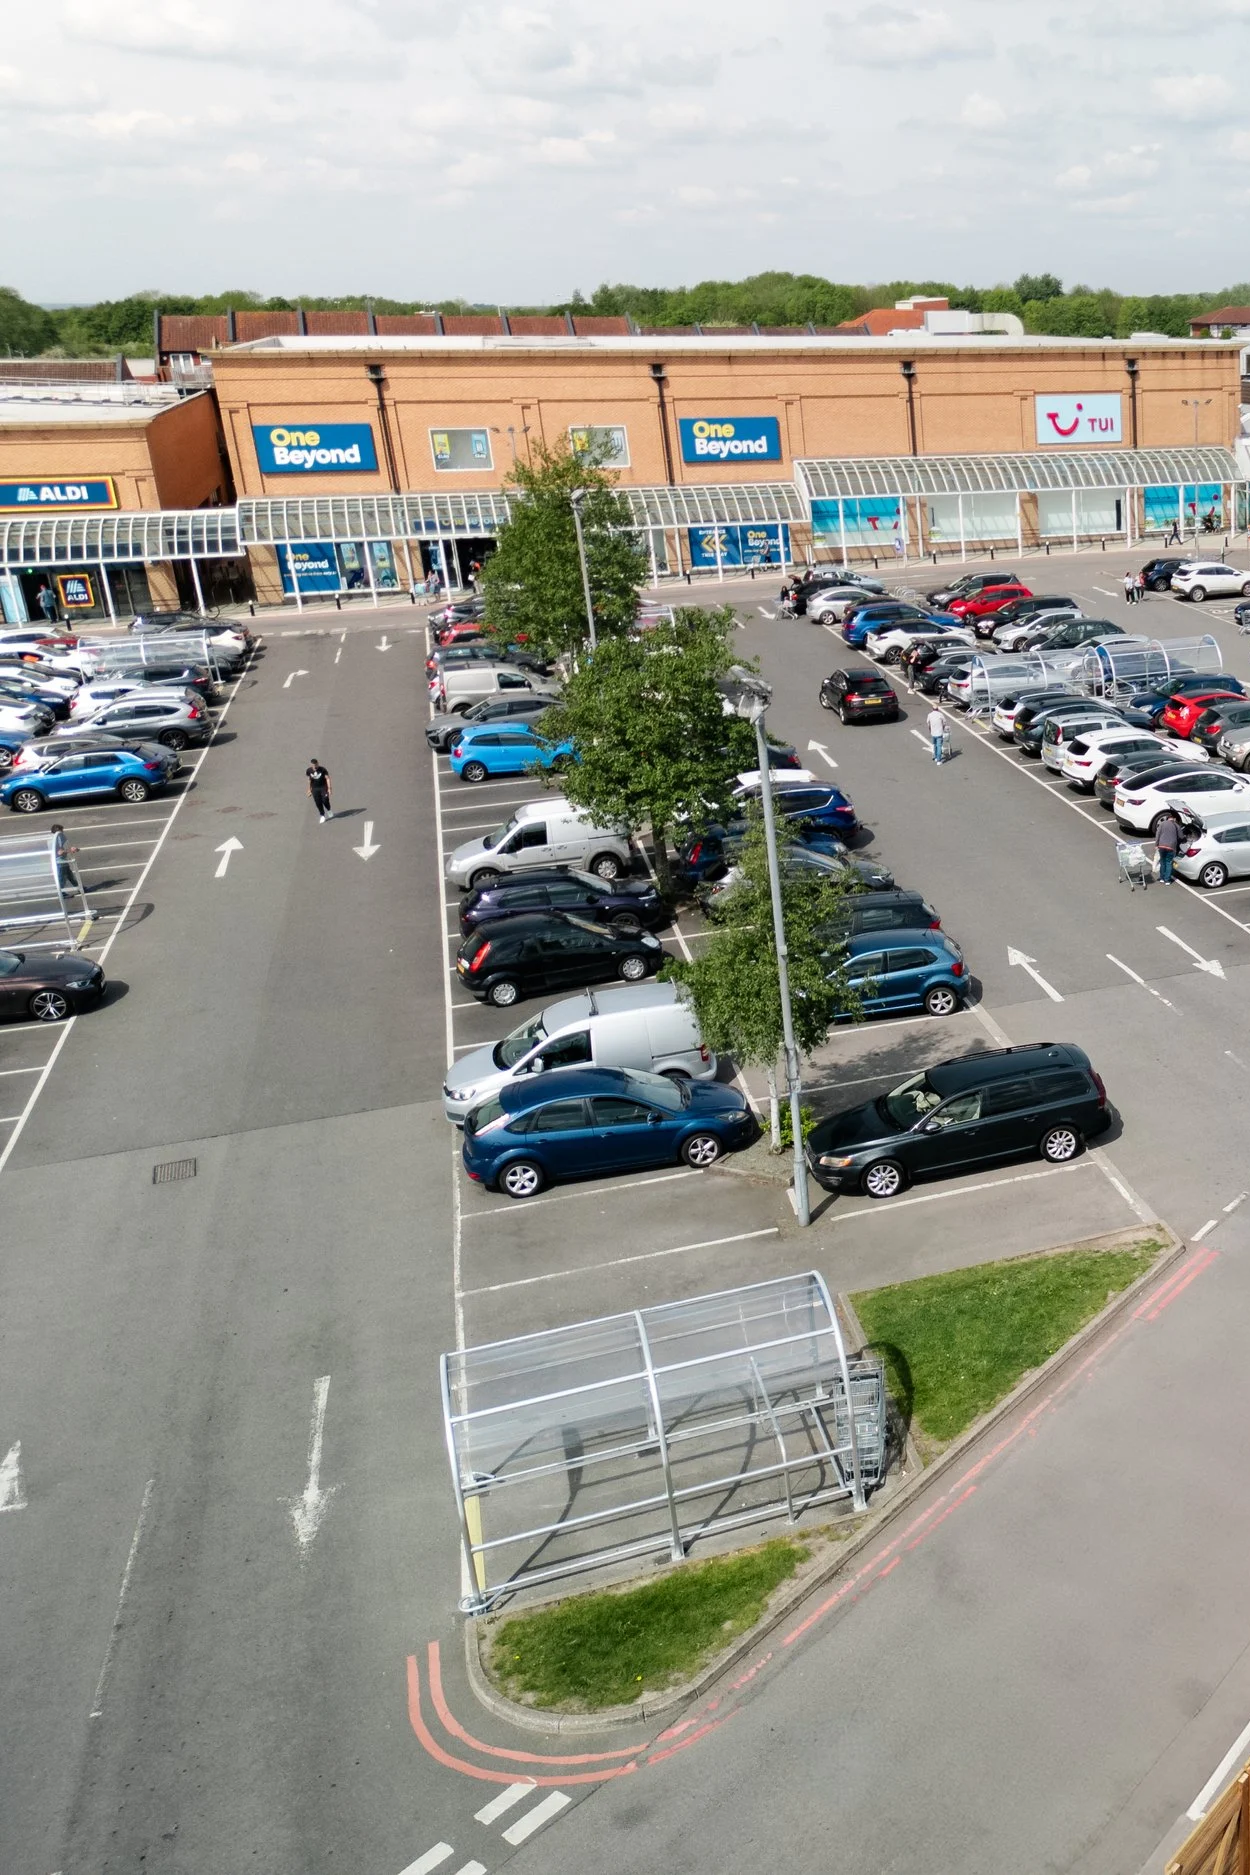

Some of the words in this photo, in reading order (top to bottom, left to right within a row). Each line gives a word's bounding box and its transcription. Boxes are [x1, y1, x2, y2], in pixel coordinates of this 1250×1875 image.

[693, 421, 735, 438] One
[1088, 418, 1114, 432] TUI
[270, 428, 320, 447] One
[695, 436, 768, 458] Beyond
[273, 444, 361, 468] Beyond
[40, 486, 88, 501] ALDI
[747, 530, 767, 539] One
[67, 593, 89, 601] ALDI
